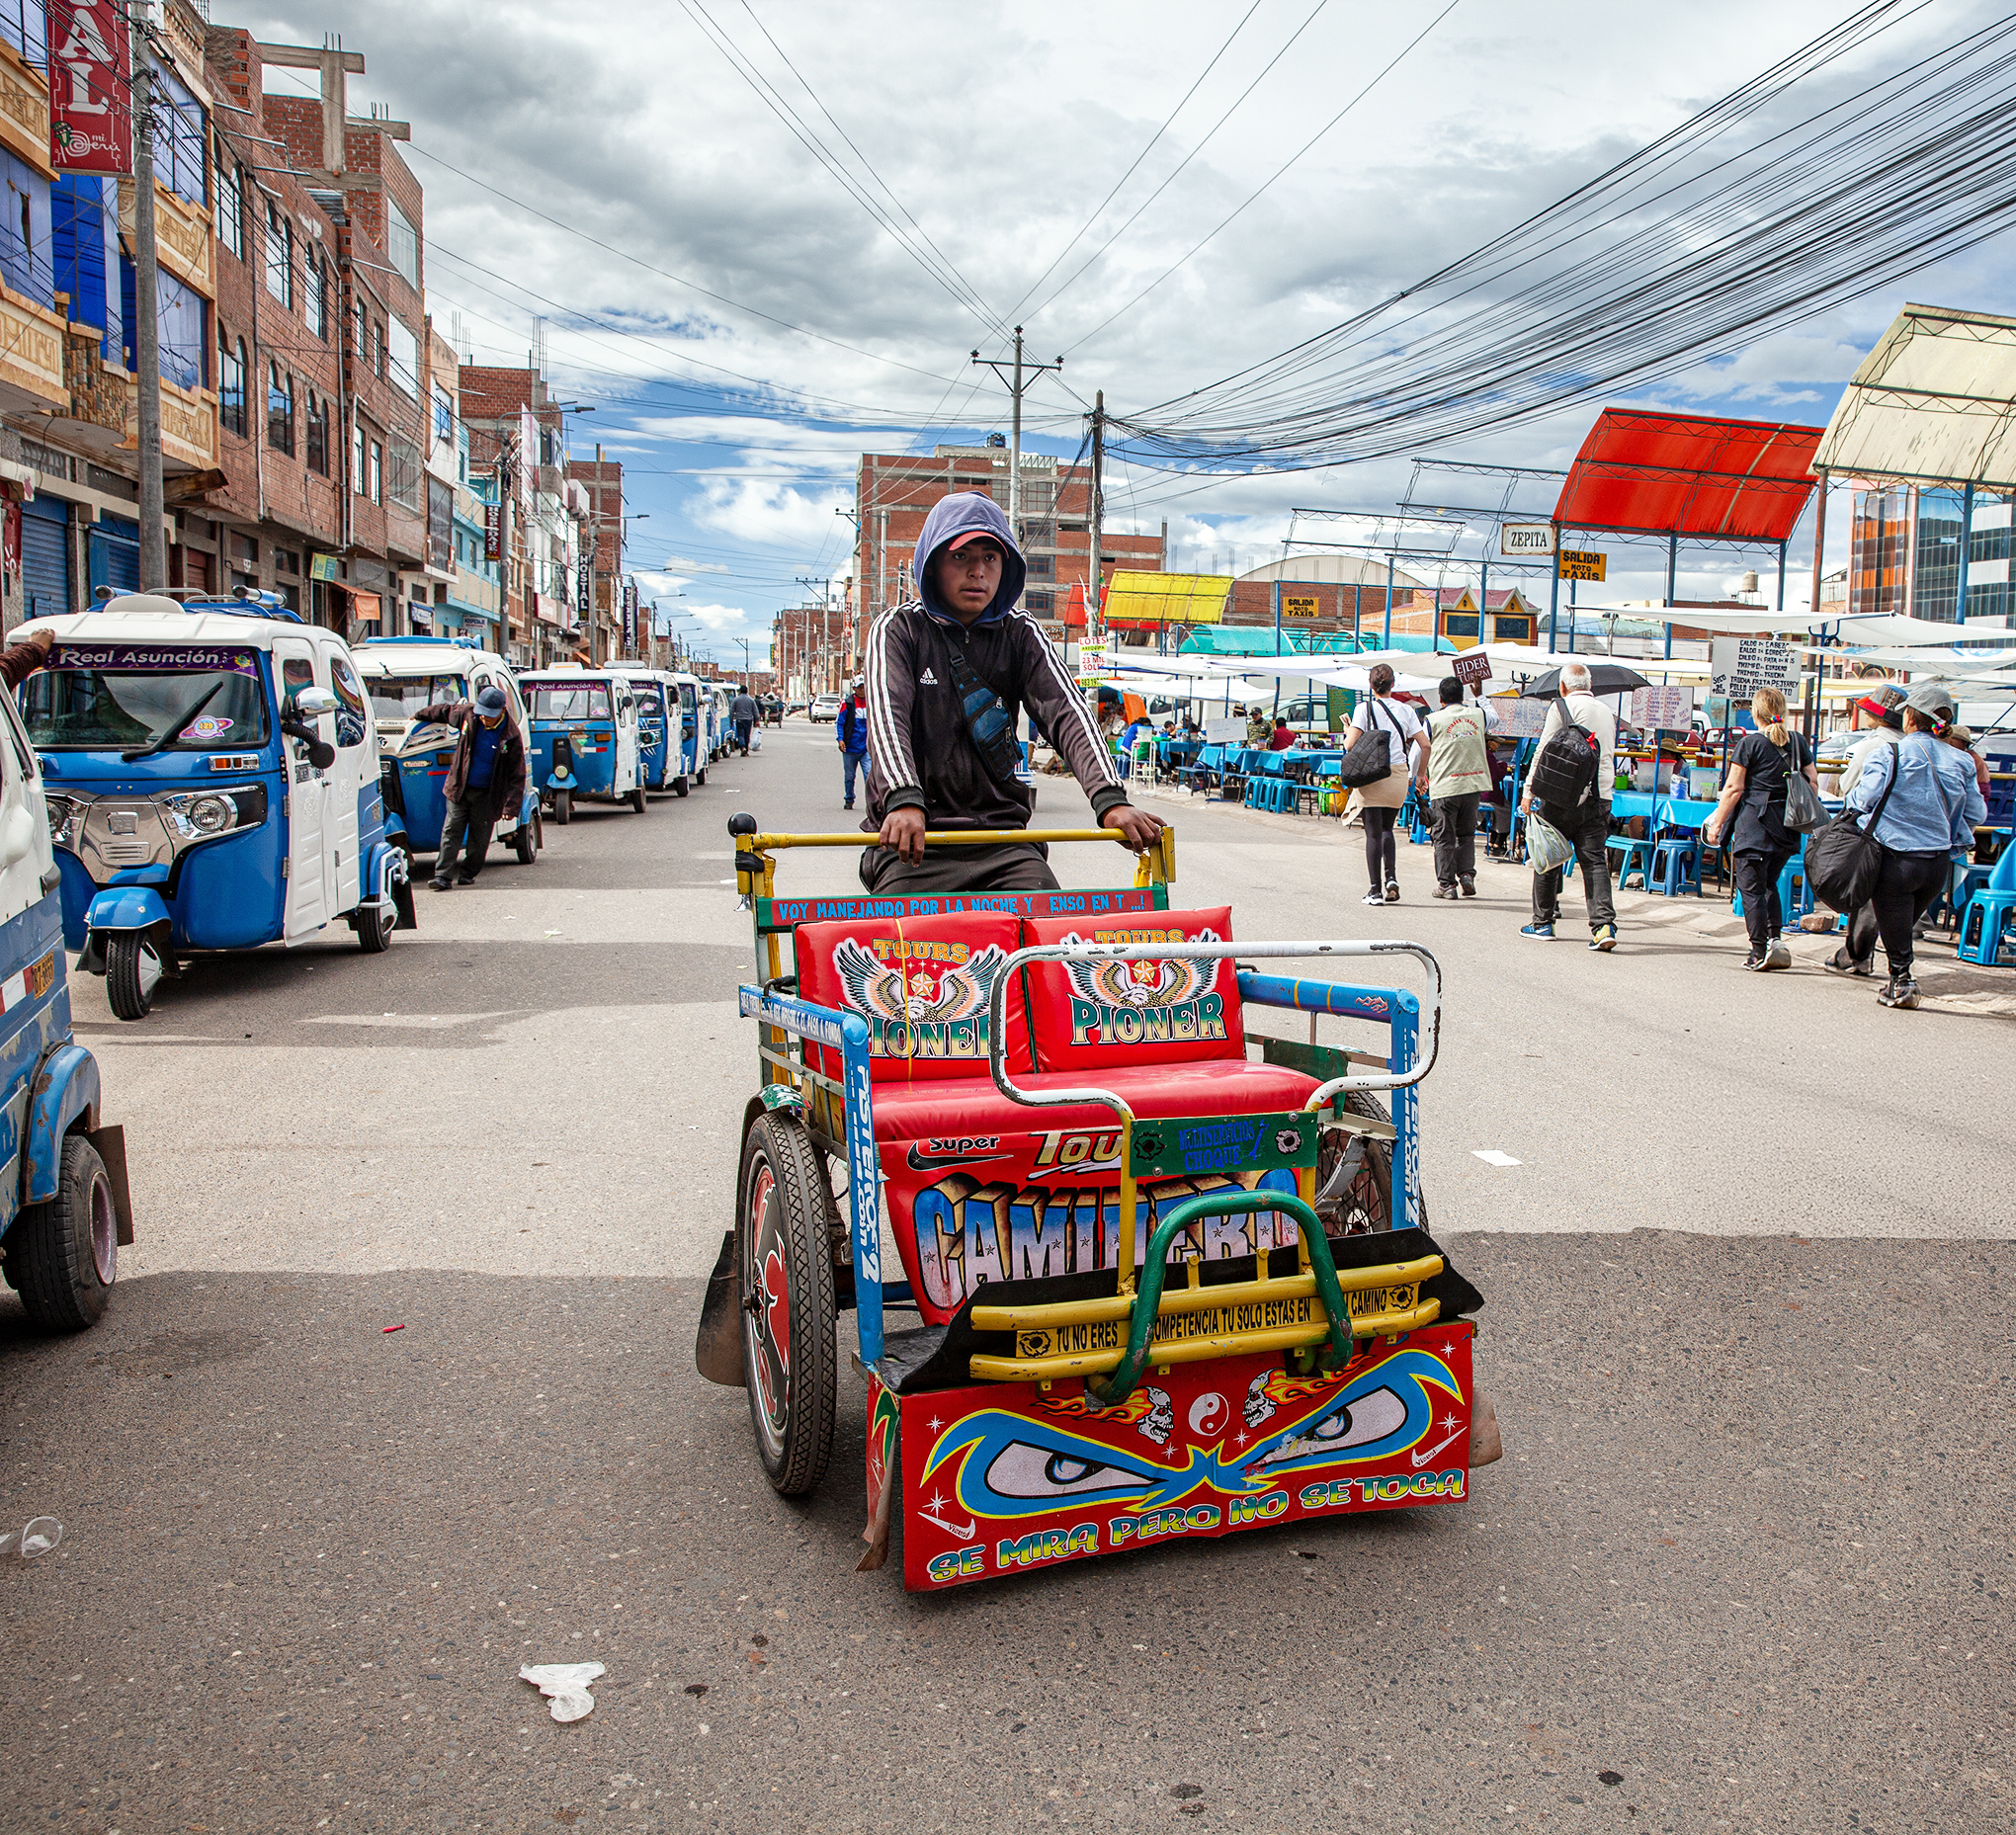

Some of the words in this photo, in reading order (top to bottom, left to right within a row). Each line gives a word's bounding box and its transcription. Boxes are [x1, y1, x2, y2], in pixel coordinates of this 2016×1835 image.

[58, 0, 114, 115] AL
[1511, 532, 1547, 547] ZEPITA
[1563, 552, 1600, 565] SALIDA
[579, 554, 588, 610] HOSTAL
[1562, 570, 1599, 581] TAXIS
[59, 649, 114, 666] Real
[122, 650, 219, 665] Asunción
[1456, 658, 1488, 674] EJDER
[778, 903, 808, 920] VOY
[817, 900, 904, 919] MANEJANDO
[910, 900, 938, 916] POR
[946, 899, 964, 912] LA
[971, 898, 1018, 914] NOCHE
[1024, 897, 1033, 913] Y
[1092, 894, 1109, 913] EN
[1115, 894, 1124, 909] T
[1095, 929, 1184, 944] TOURS
[873, 938, 969, 965] TOURS
[1066, 992, 1229, 1046] PIONER
[929, 1136, 1000, 1154] Super
[1179, 1120, 1254, 1150] MULTISERVICIOS
[1185, 1145, 1243, 1172] CHOQUE
[862, 1250, 880, 1283] 2
[1057, 1326, 1069, 1352] TU
[1073, 1324, 1087, 1350] NO
[1091, 1322, 1118, 1348] ERES
[1152, 1310, 1219, 1342] OMPETENCIA
[1221, 1308, 1234, 1333] TU
[1237, 1304, 1262, 1330] SOLO
[1265, 1300, 1294, 1327] ESTAS
[1298, 1297, 1311, 1322] EN
[1352, 1289, 1387, 1316] CAMINO
[927, 1545, 986, 1582] SE
[997, 1523, 1098, 1568] MIRA
[1109, 1504, 1220, 1546] PERO
[1229, 1491, 1288, 1525] NO
[1300, 1479, 1352, 1508] SE
[1353, 1469, 1465, 1502] TOCA
